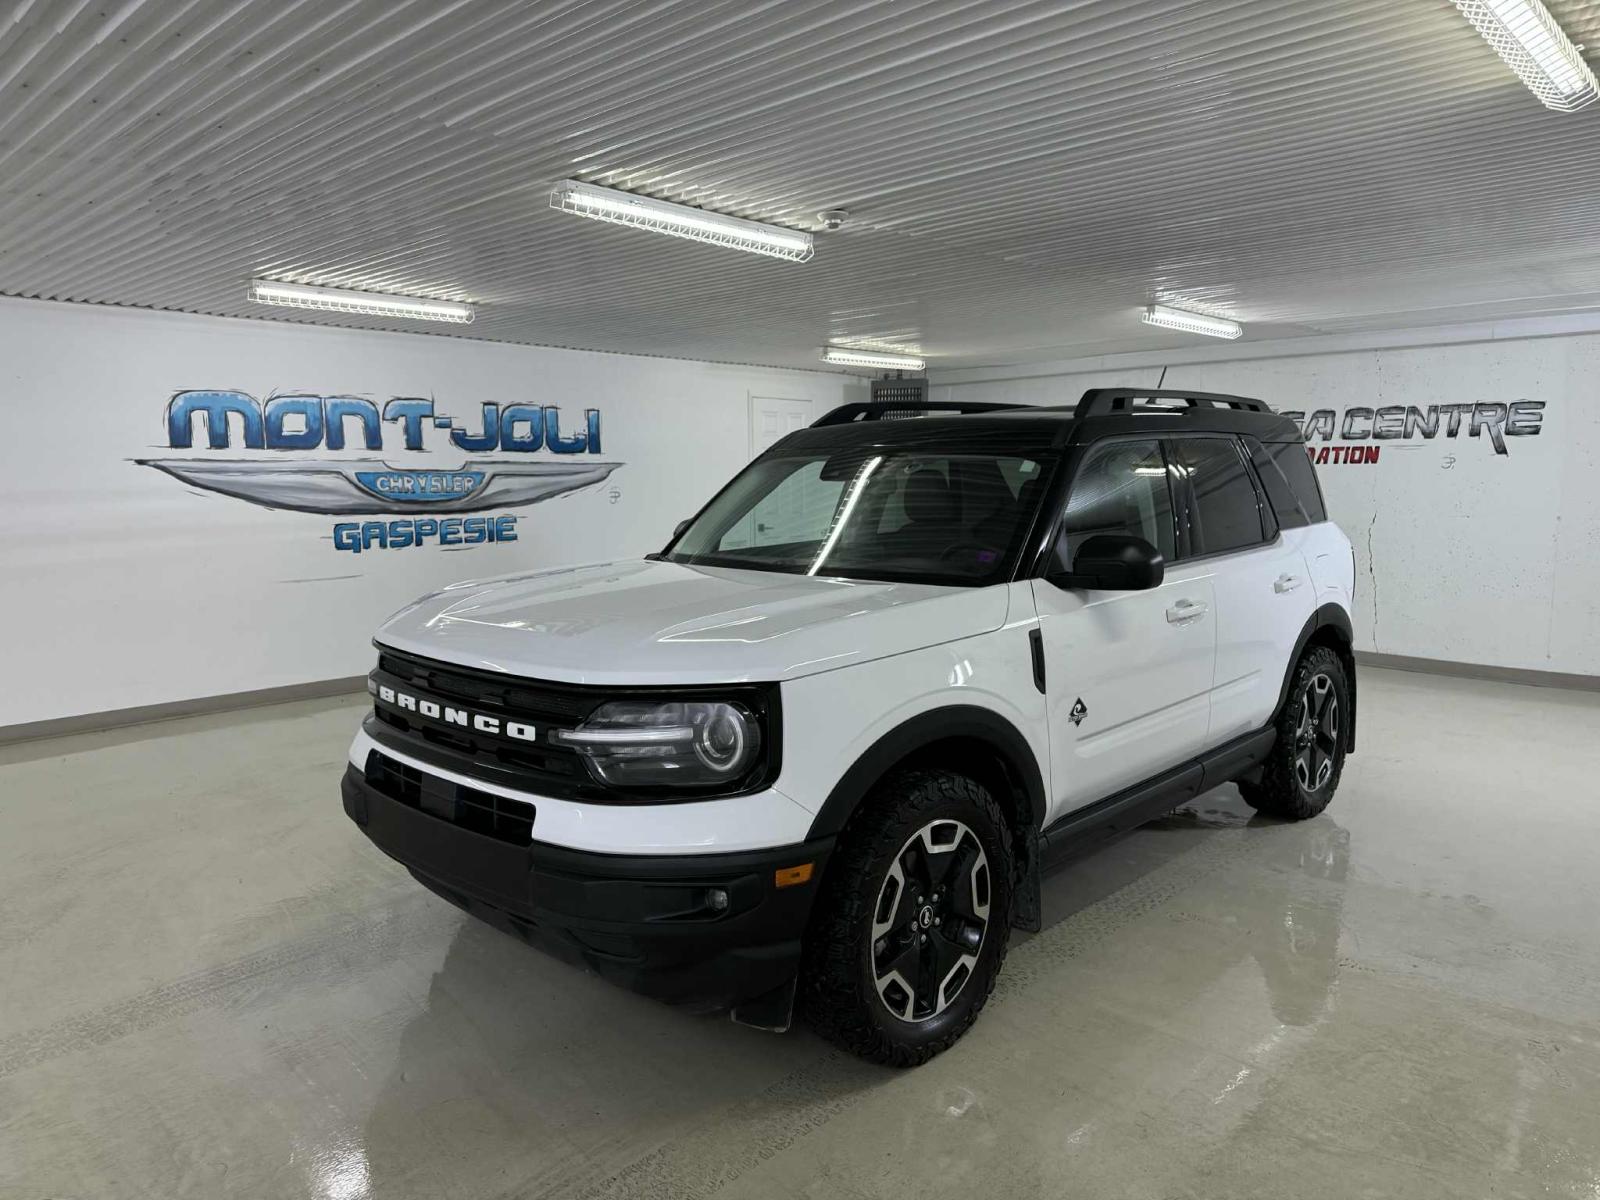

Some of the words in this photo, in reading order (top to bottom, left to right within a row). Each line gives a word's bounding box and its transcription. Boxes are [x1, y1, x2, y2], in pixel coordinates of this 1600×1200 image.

[376, 476, 474, 492] CHRYSLER
[333, 515, 518, 553] GASPESIE
[379, 685, 536, 742] BRONCO
